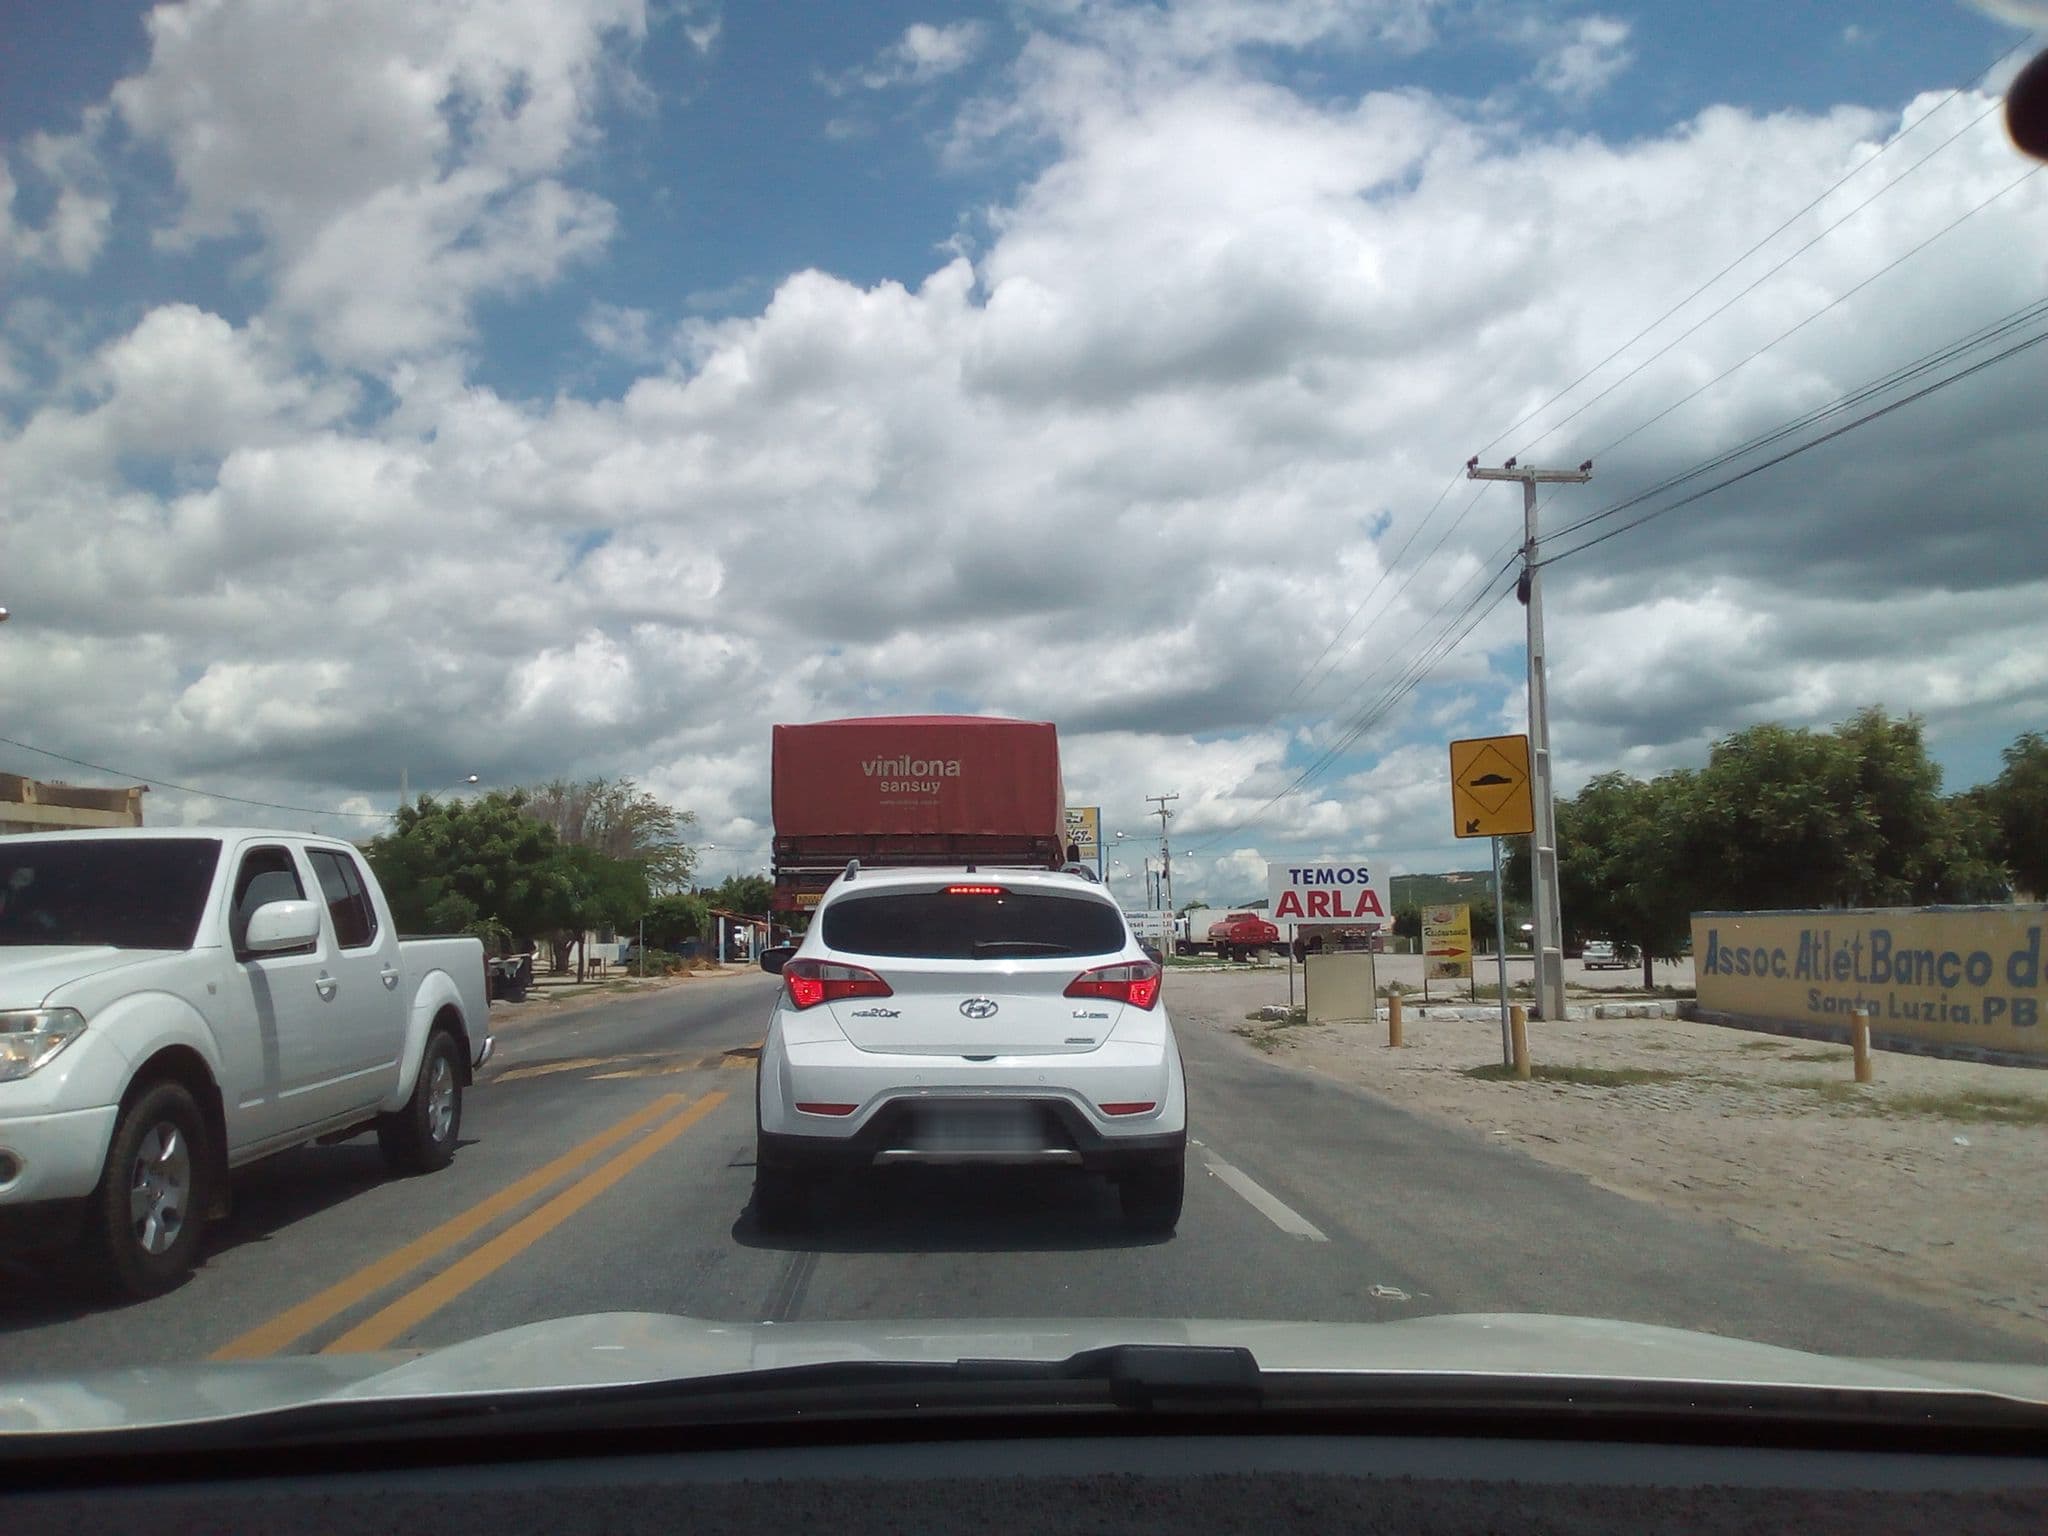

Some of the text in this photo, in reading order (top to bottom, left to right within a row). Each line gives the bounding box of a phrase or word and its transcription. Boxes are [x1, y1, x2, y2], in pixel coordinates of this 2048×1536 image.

[861, 754, 961, 777] vinilona
[879, 780, 941, 795] sansuy
[1288, 867, 1370, 885] TEMOS
[1275, 889, 1385, 918] ARLA
[1869, 928, 1993, 989] Banco
[2006, 926, 2048, 988] d
[1807, 987, 1880, 1018] Santa
